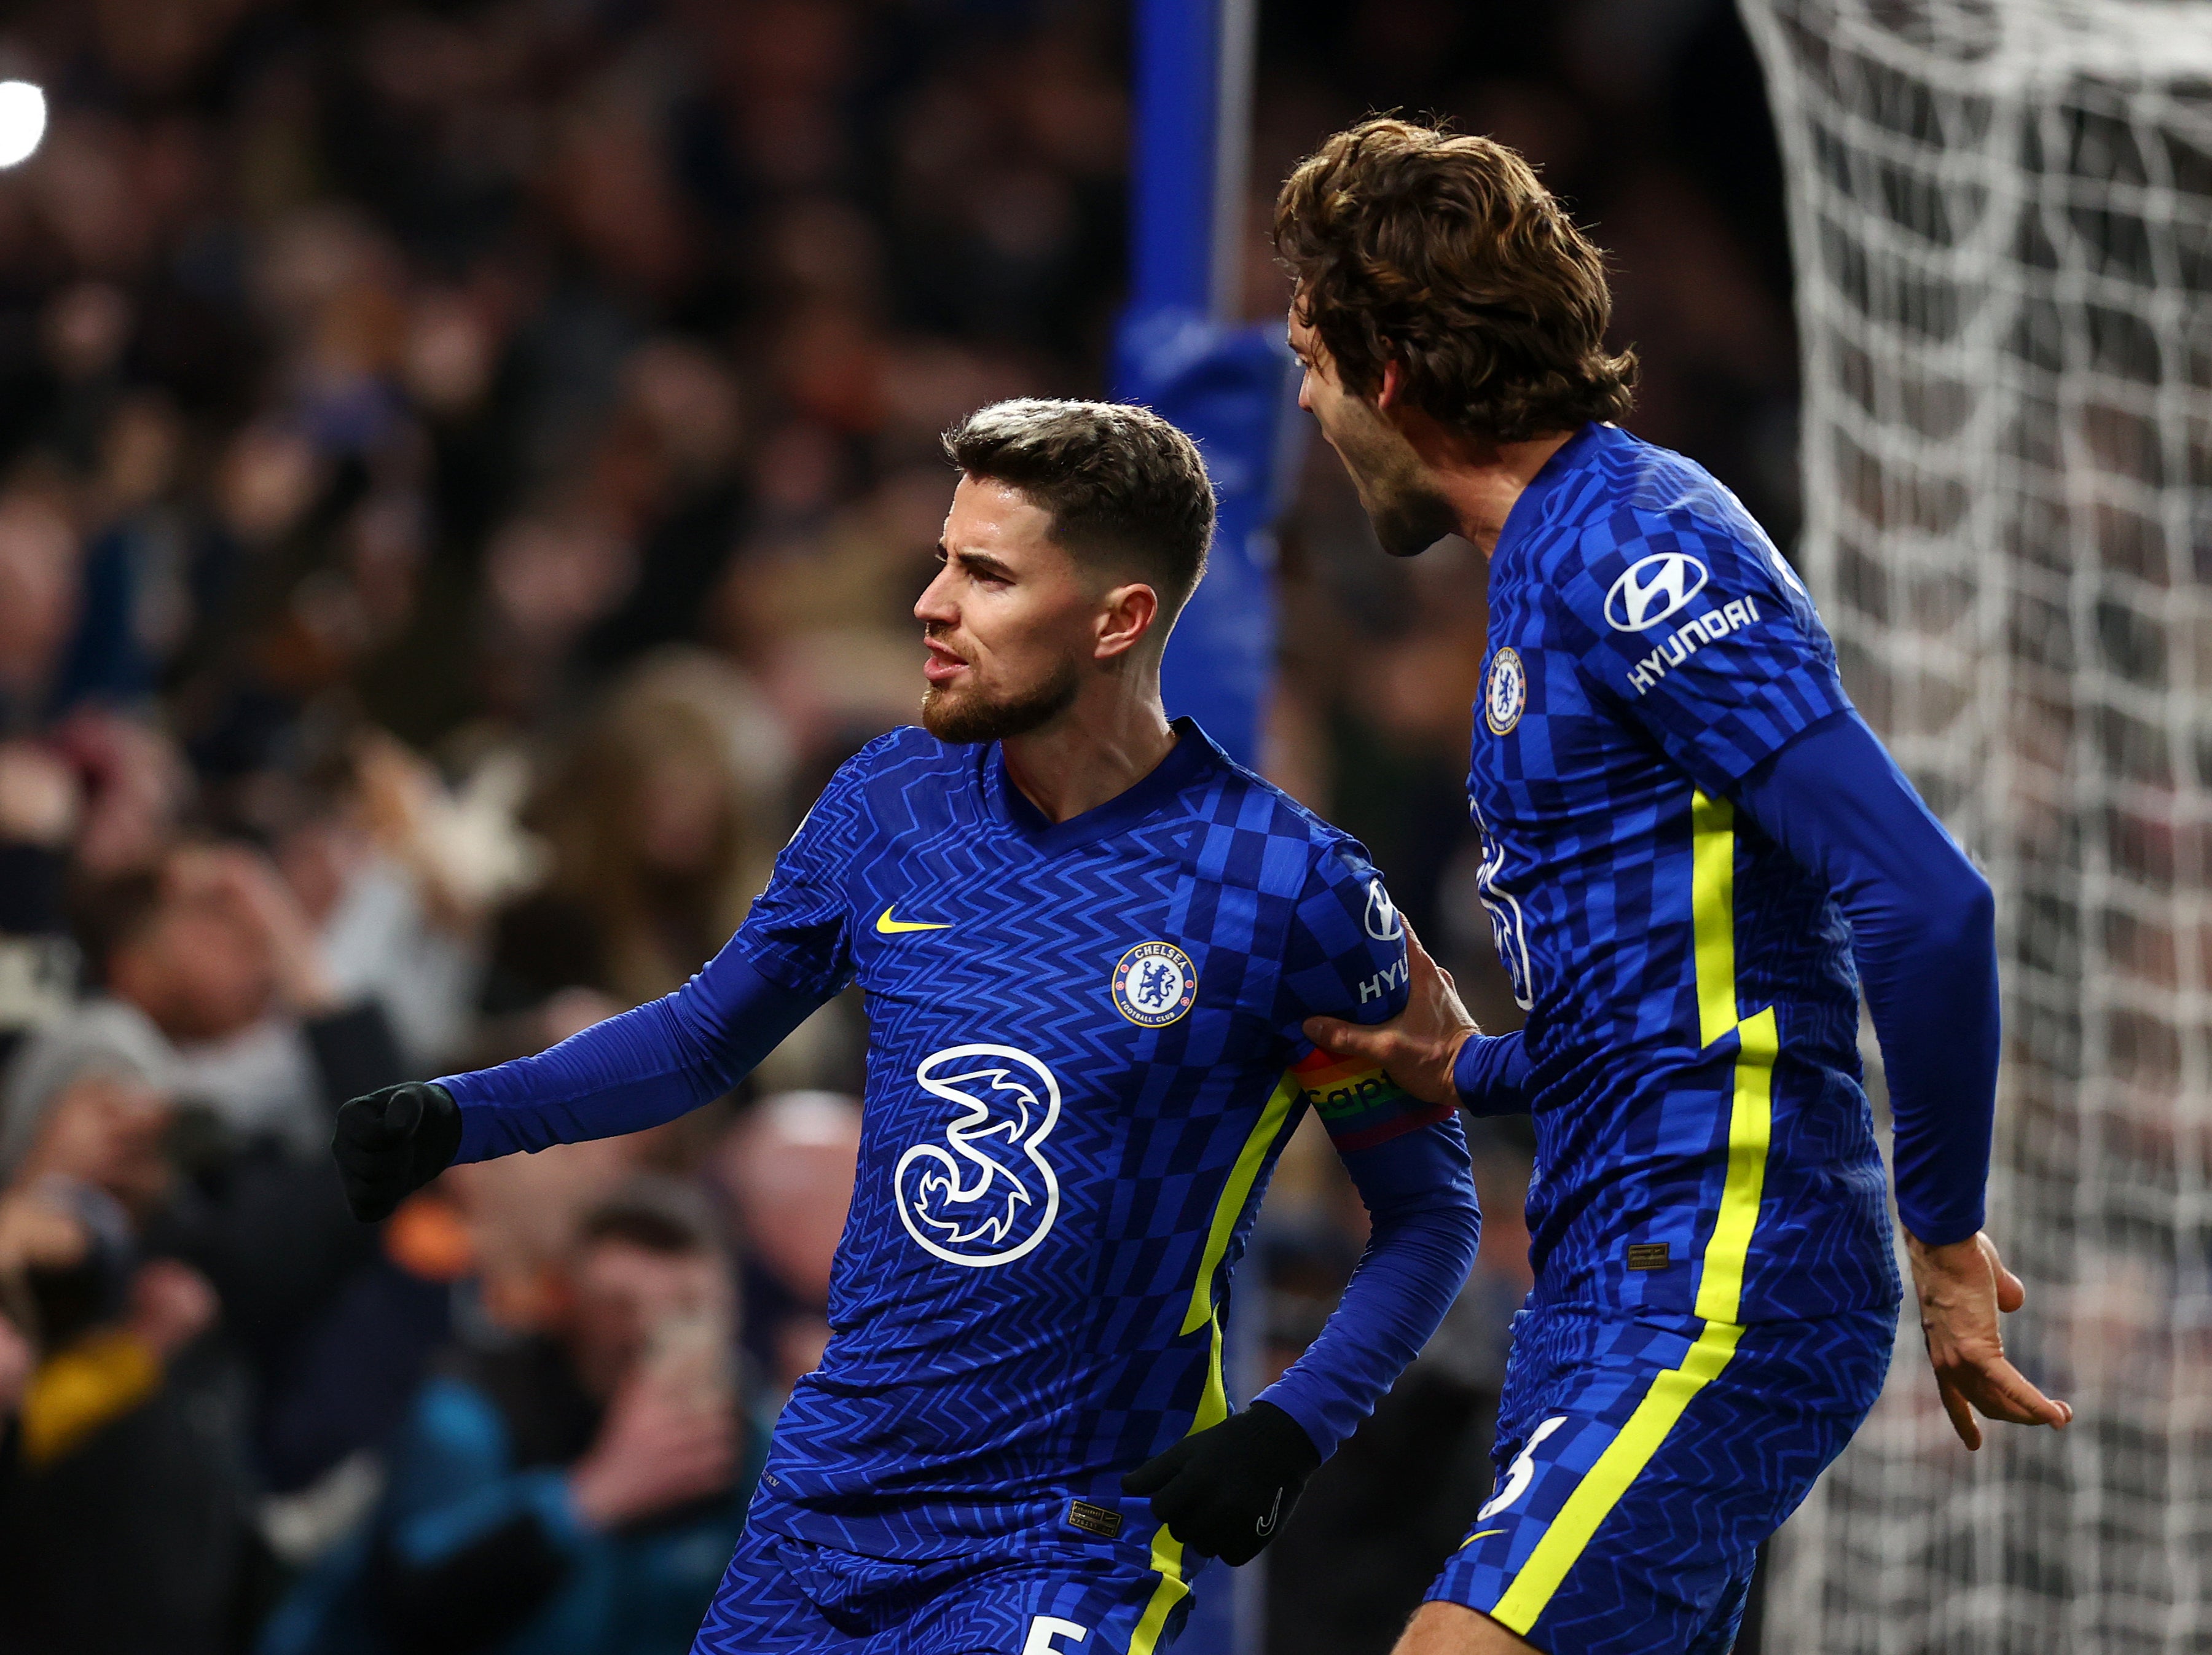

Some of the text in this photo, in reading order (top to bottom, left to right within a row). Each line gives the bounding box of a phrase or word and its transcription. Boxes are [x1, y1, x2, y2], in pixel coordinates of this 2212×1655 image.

[1626, 595, 1760, 695] HYUNDAI
[1135, 945, 1188, 971] CHELSEA
[1121, 1000, 1175, 1023] FOOTBALL CLUB
